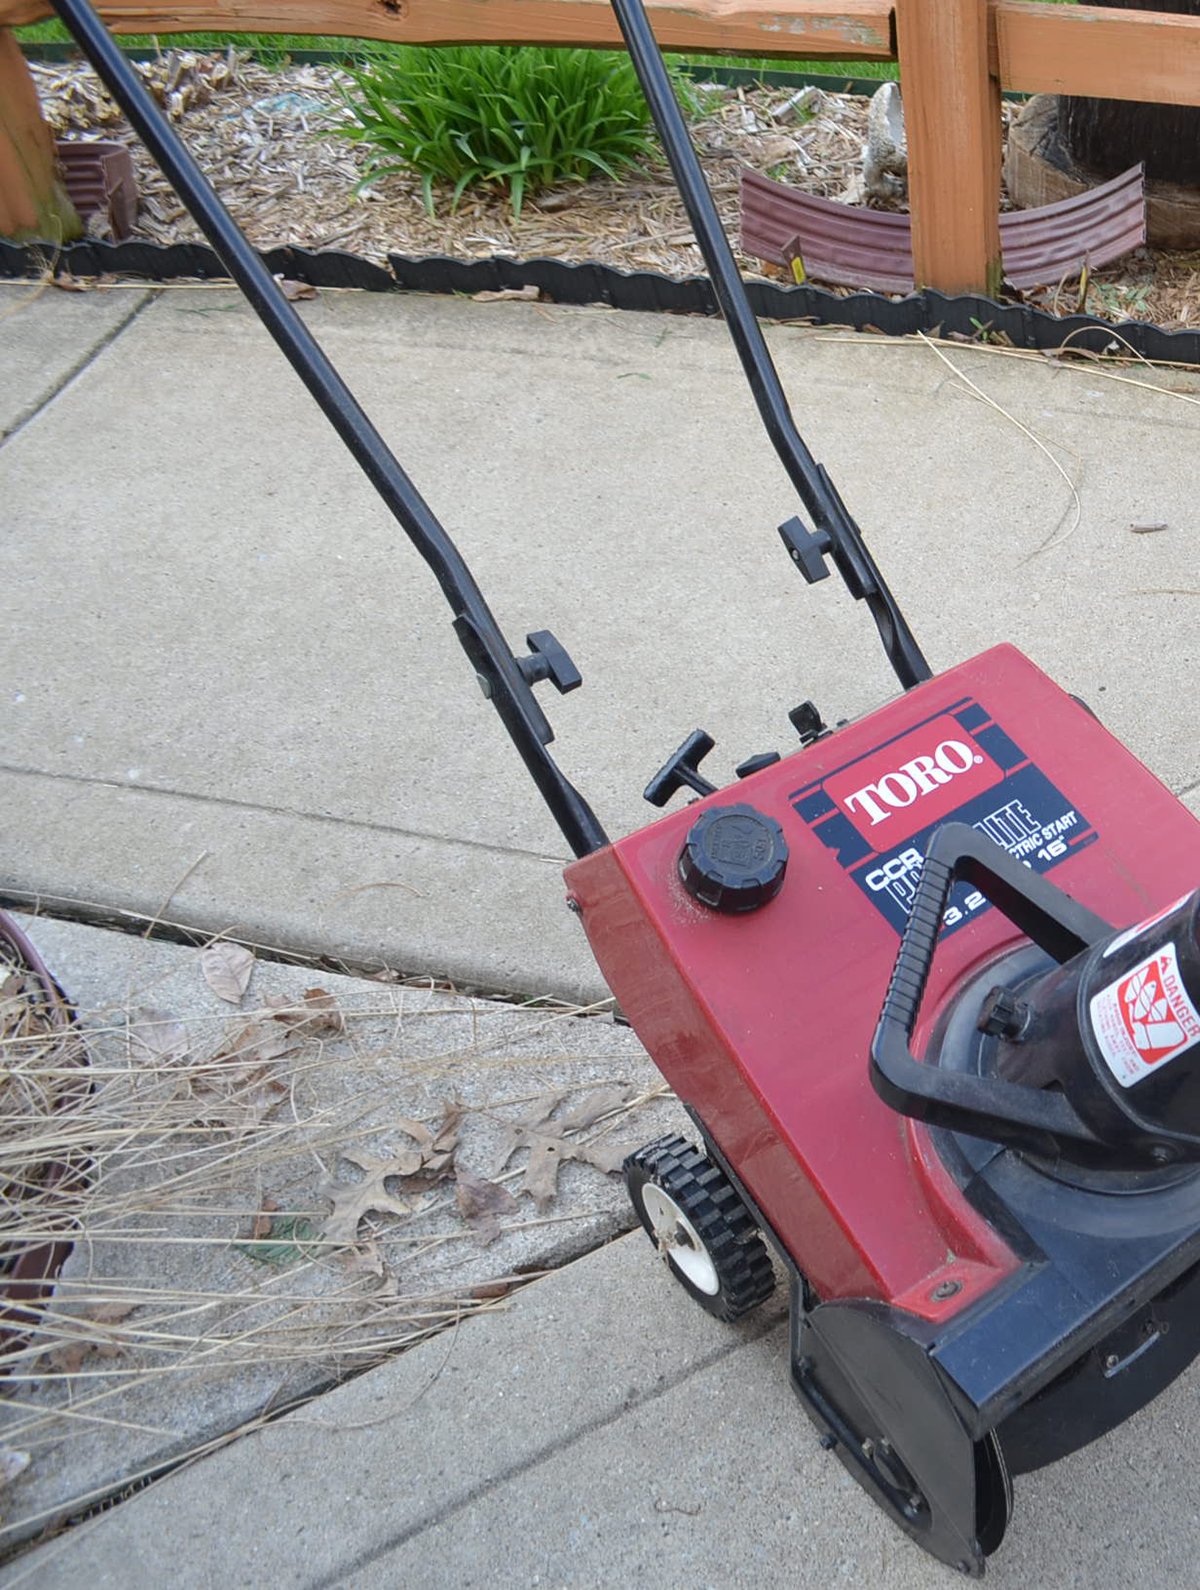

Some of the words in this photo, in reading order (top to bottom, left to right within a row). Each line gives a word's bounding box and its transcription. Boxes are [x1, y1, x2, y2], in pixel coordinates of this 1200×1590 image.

[843, 740, 973, 826] TORO
[1041, 810, 1077, 840] START
[865, 848, 925, 891] CCR
[943, 891, 987, 926] 3.2
